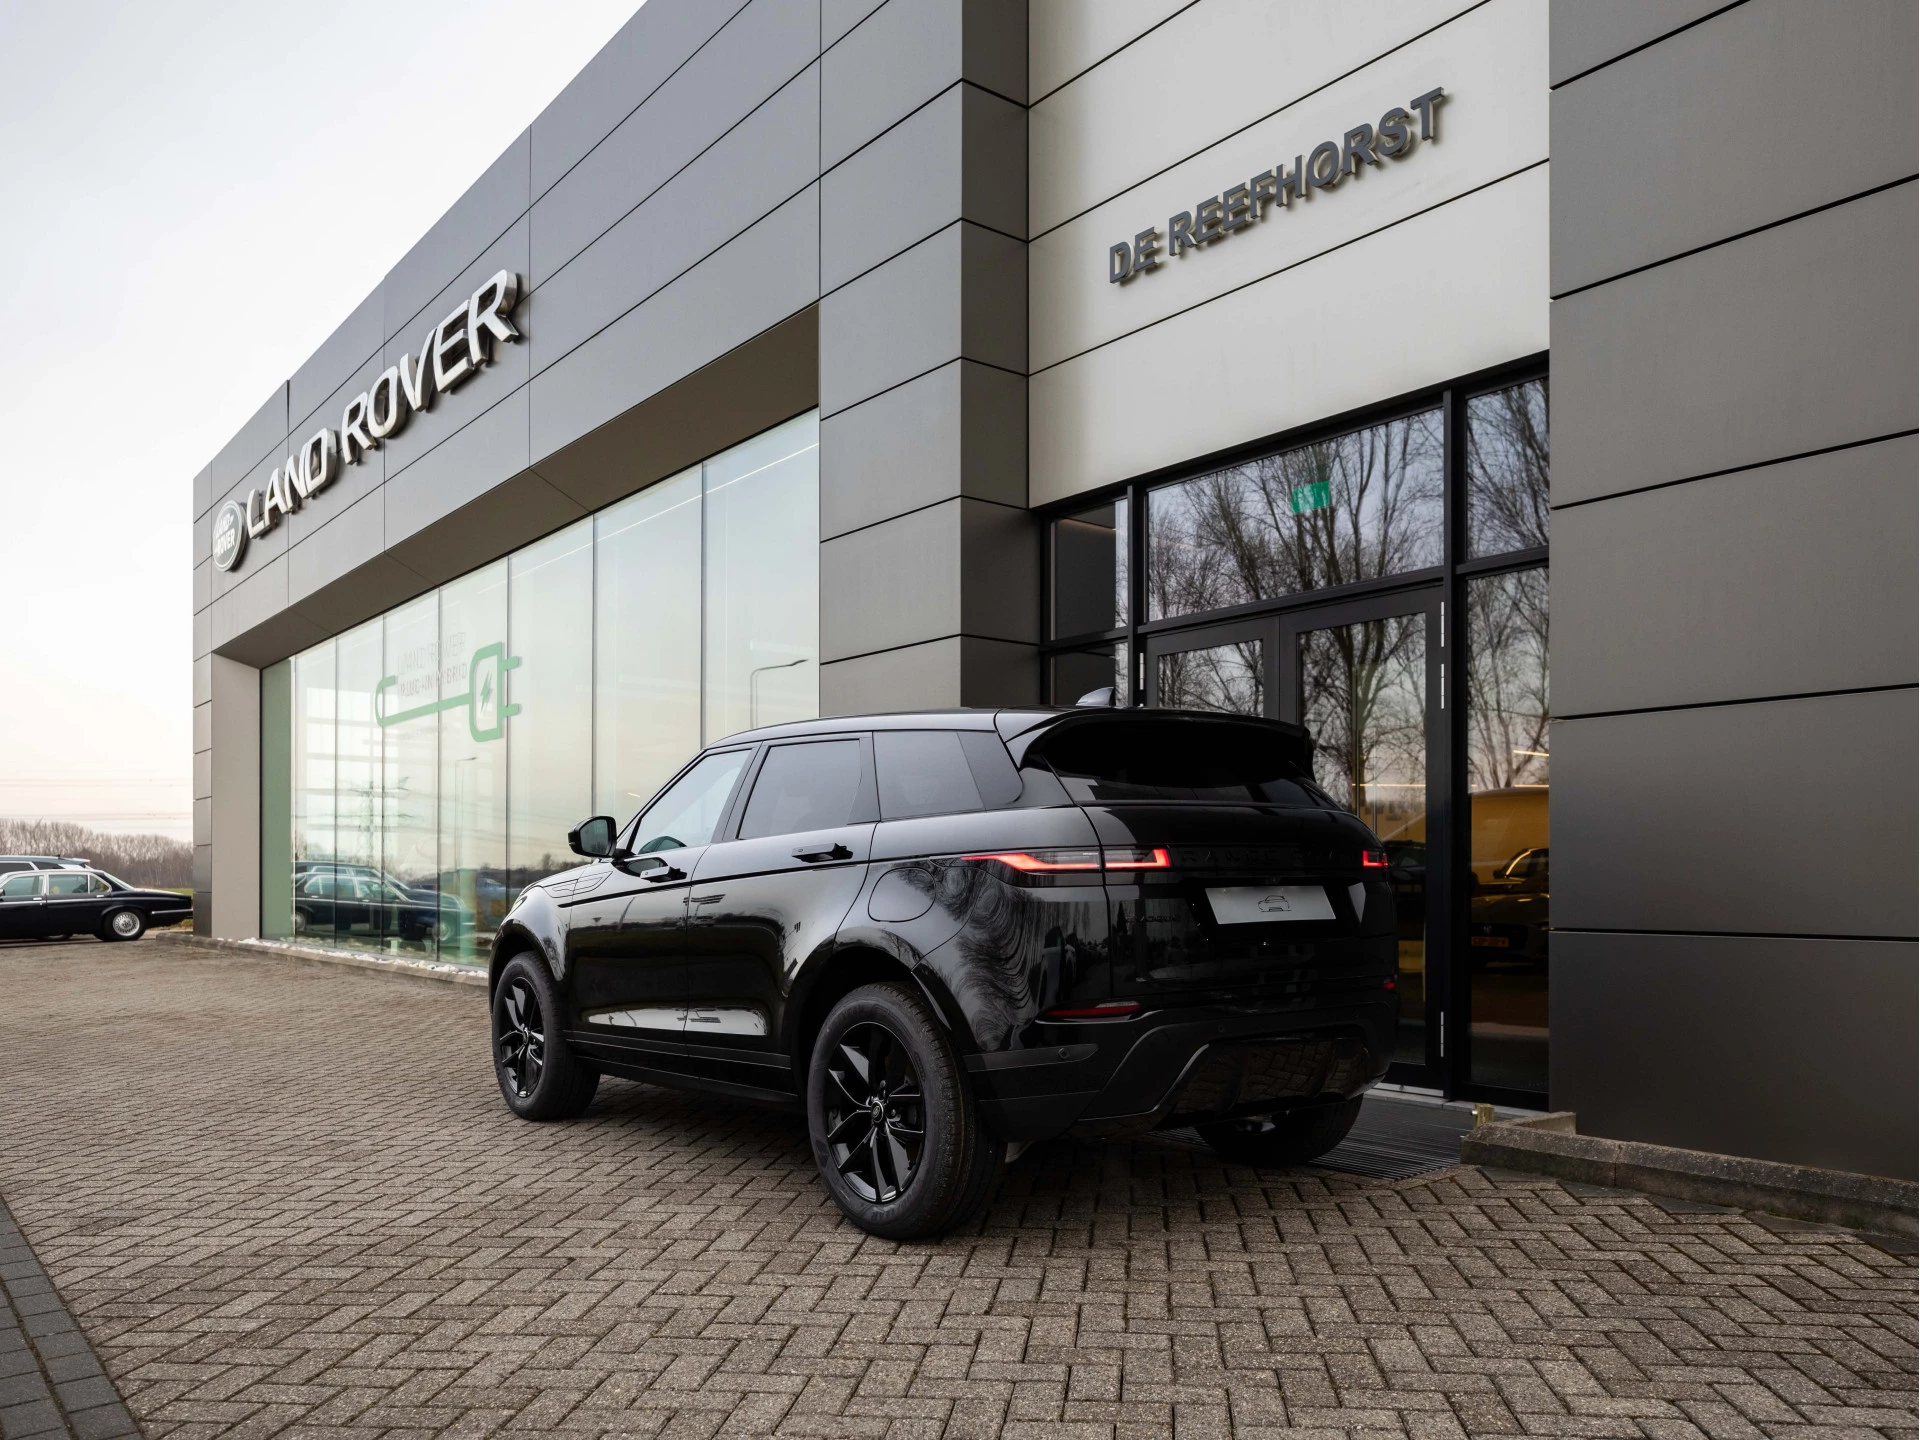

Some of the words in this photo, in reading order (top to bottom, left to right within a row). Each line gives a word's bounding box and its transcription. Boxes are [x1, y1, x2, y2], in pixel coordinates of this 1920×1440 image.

[1109, 226, 1159, 284] DE
[1168, 86, 1445, 257] REEFHORST
[246, 427, 337, 540] LAND
[341, 269, 519, 465] ROVER
